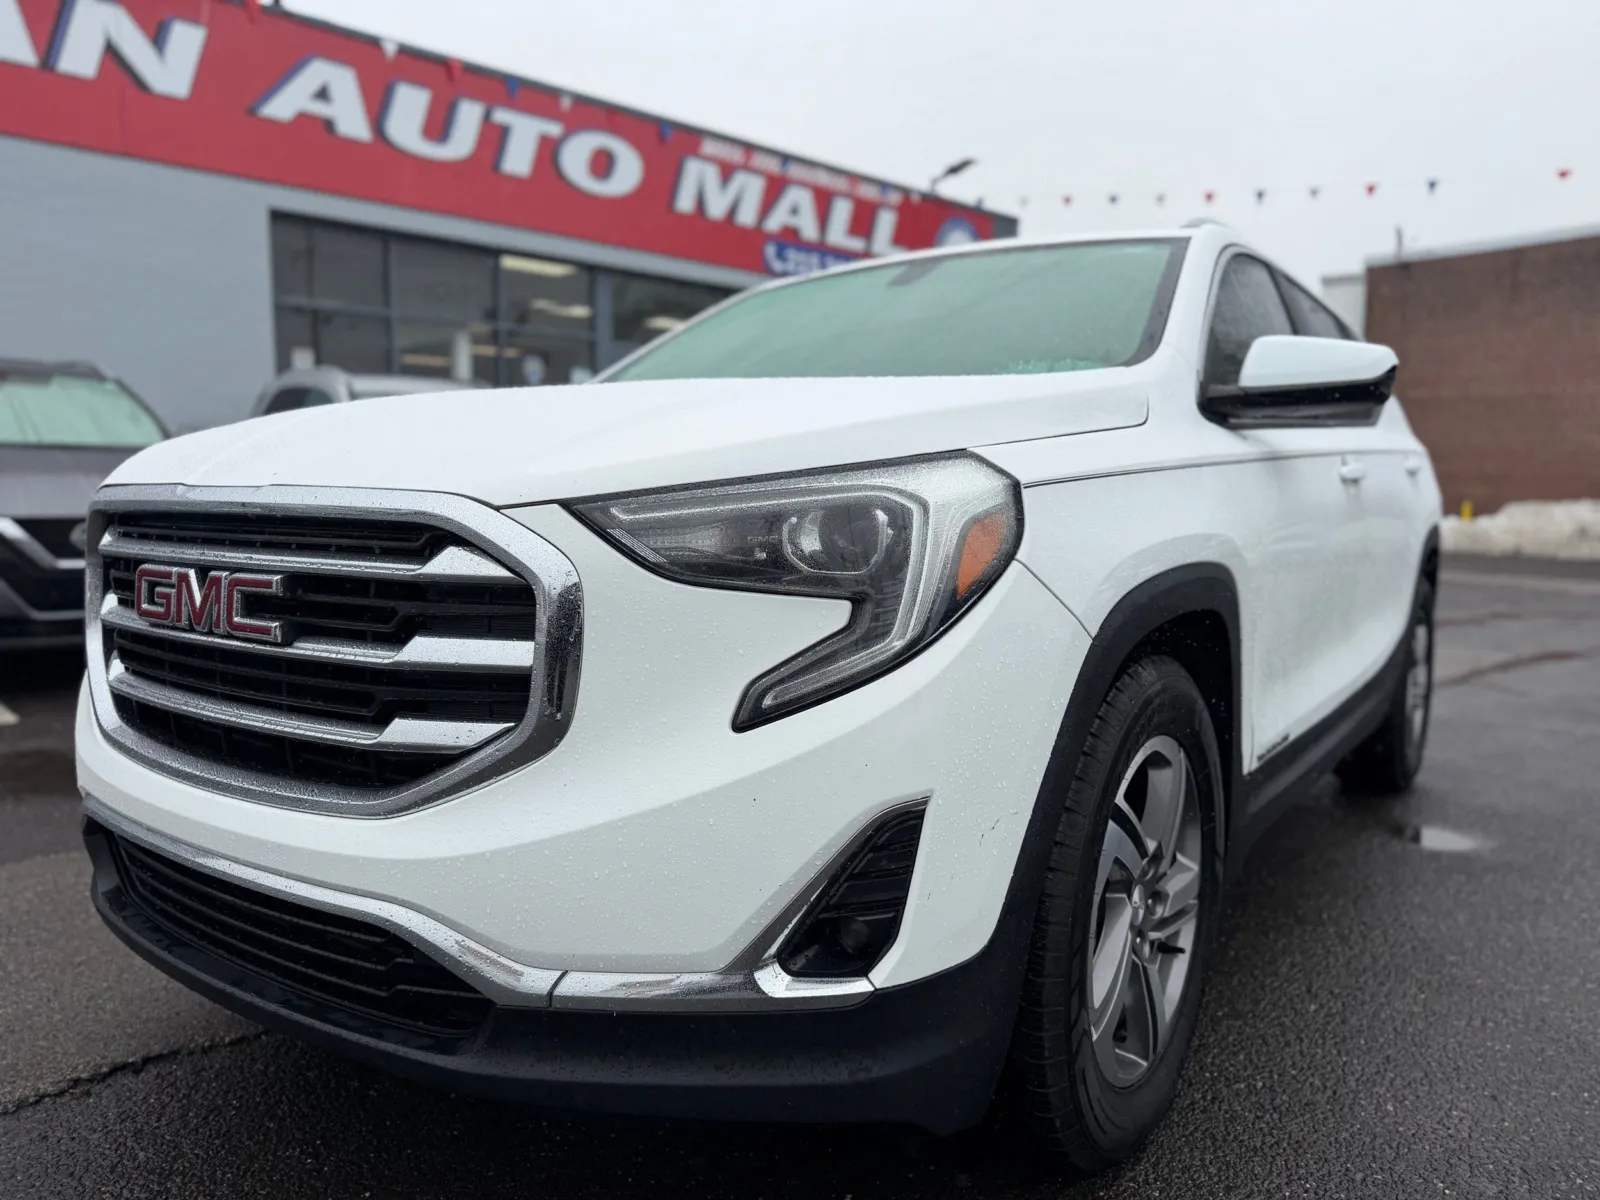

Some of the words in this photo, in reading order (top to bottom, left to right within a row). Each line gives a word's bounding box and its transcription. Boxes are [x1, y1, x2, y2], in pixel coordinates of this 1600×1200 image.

[250, 55, 645, 198] AUTO
[671, 154, 907, 257] MALL
[135, 563, 284, 643] GMC
